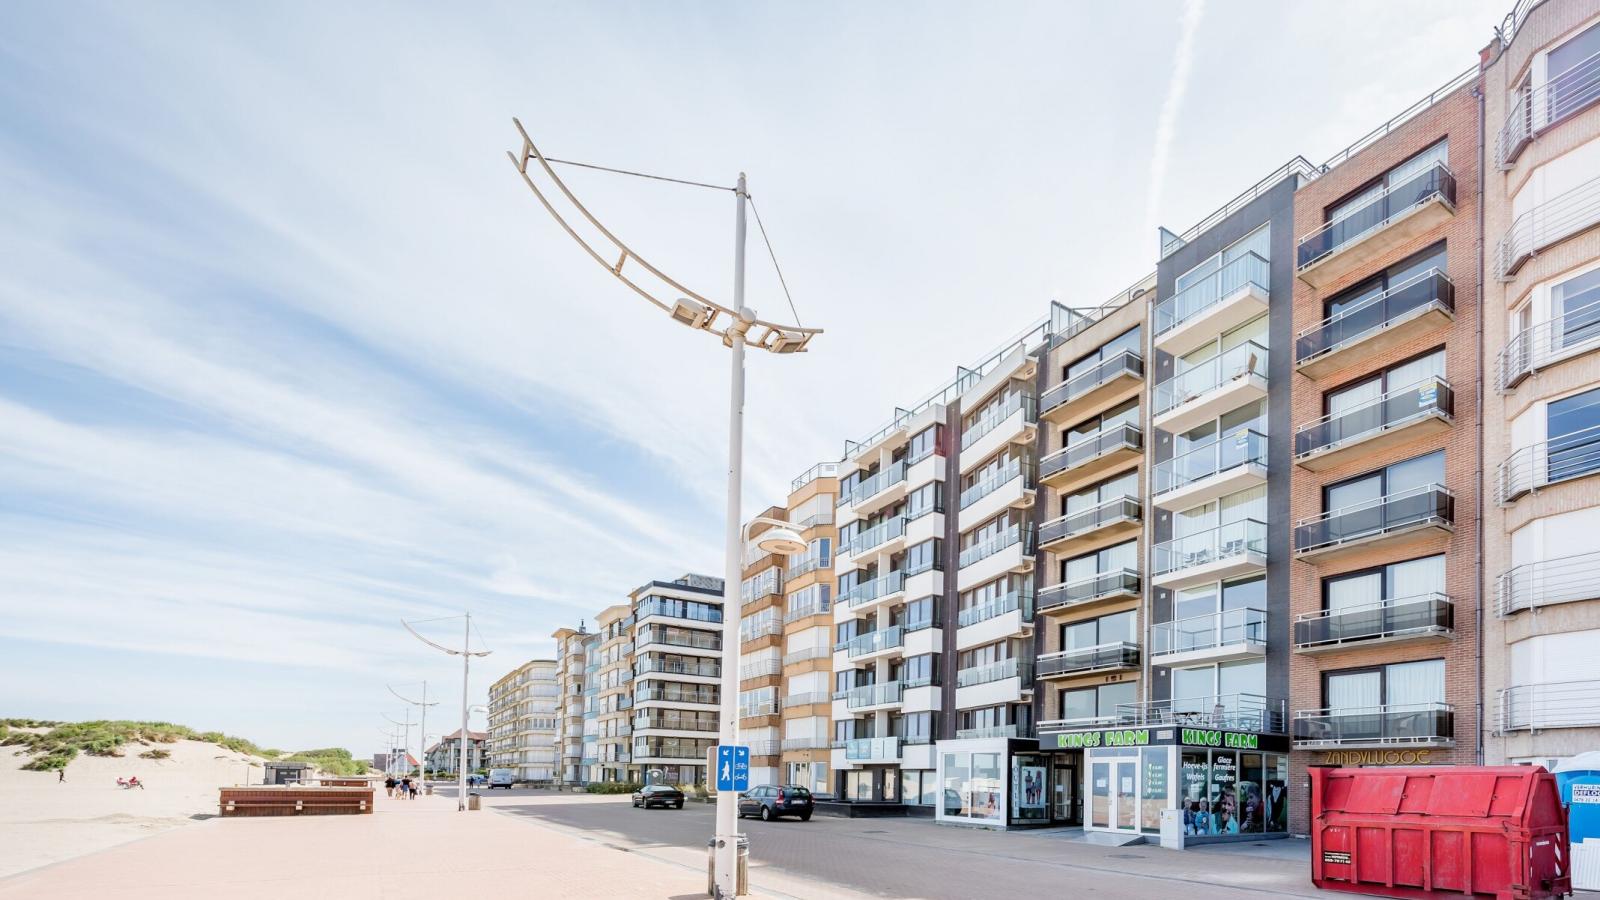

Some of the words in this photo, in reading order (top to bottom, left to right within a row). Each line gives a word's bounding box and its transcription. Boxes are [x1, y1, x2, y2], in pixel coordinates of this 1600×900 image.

[1057, 732, 1100, 748] KINGS
[1105, 729, 1150, 746] FARM
[1182, 728, 1222, 746] KINGS
[1225, 732, 1258, 749] FARM
[1217, 756, 1232, 764] Glace
[1186, 773, 1205, 782] Wafels
[1215, 773, 1235, 782] Gaufres
